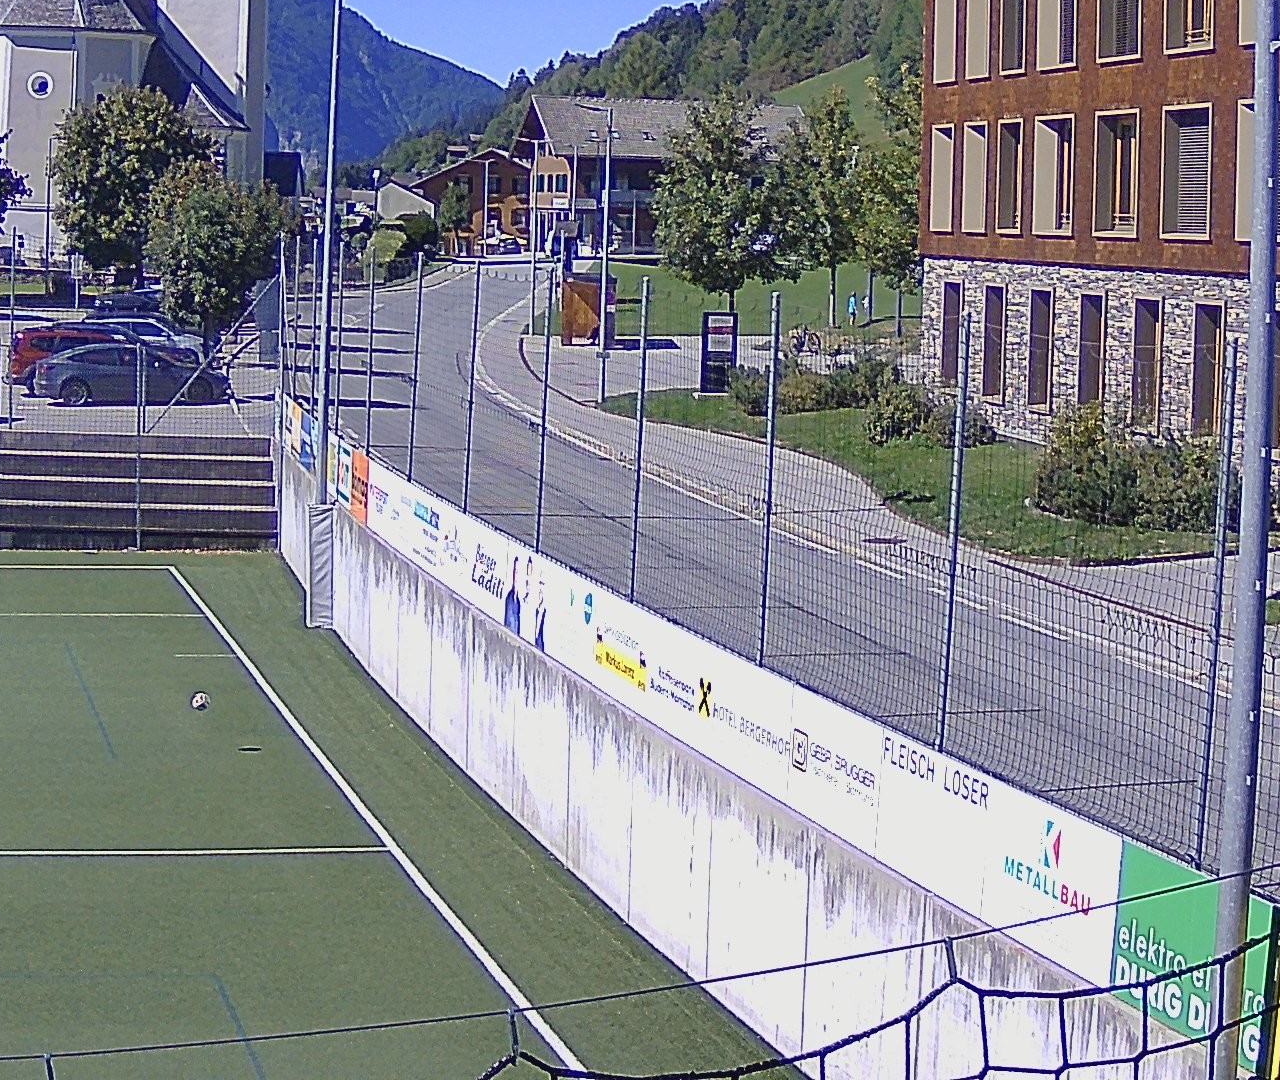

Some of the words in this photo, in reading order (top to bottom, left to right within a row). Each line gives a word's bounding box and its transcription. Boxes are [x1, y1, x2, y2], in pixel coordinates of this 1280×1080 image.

[712, 702, 738, 730] HOTEL
[883, 736, 935, 783] FLEISCH
[943, 765, 990, 811] LOSER
[1004, 856, 1091, 917] METALLBAU
[1118, 918, 1186, 973] elektro
